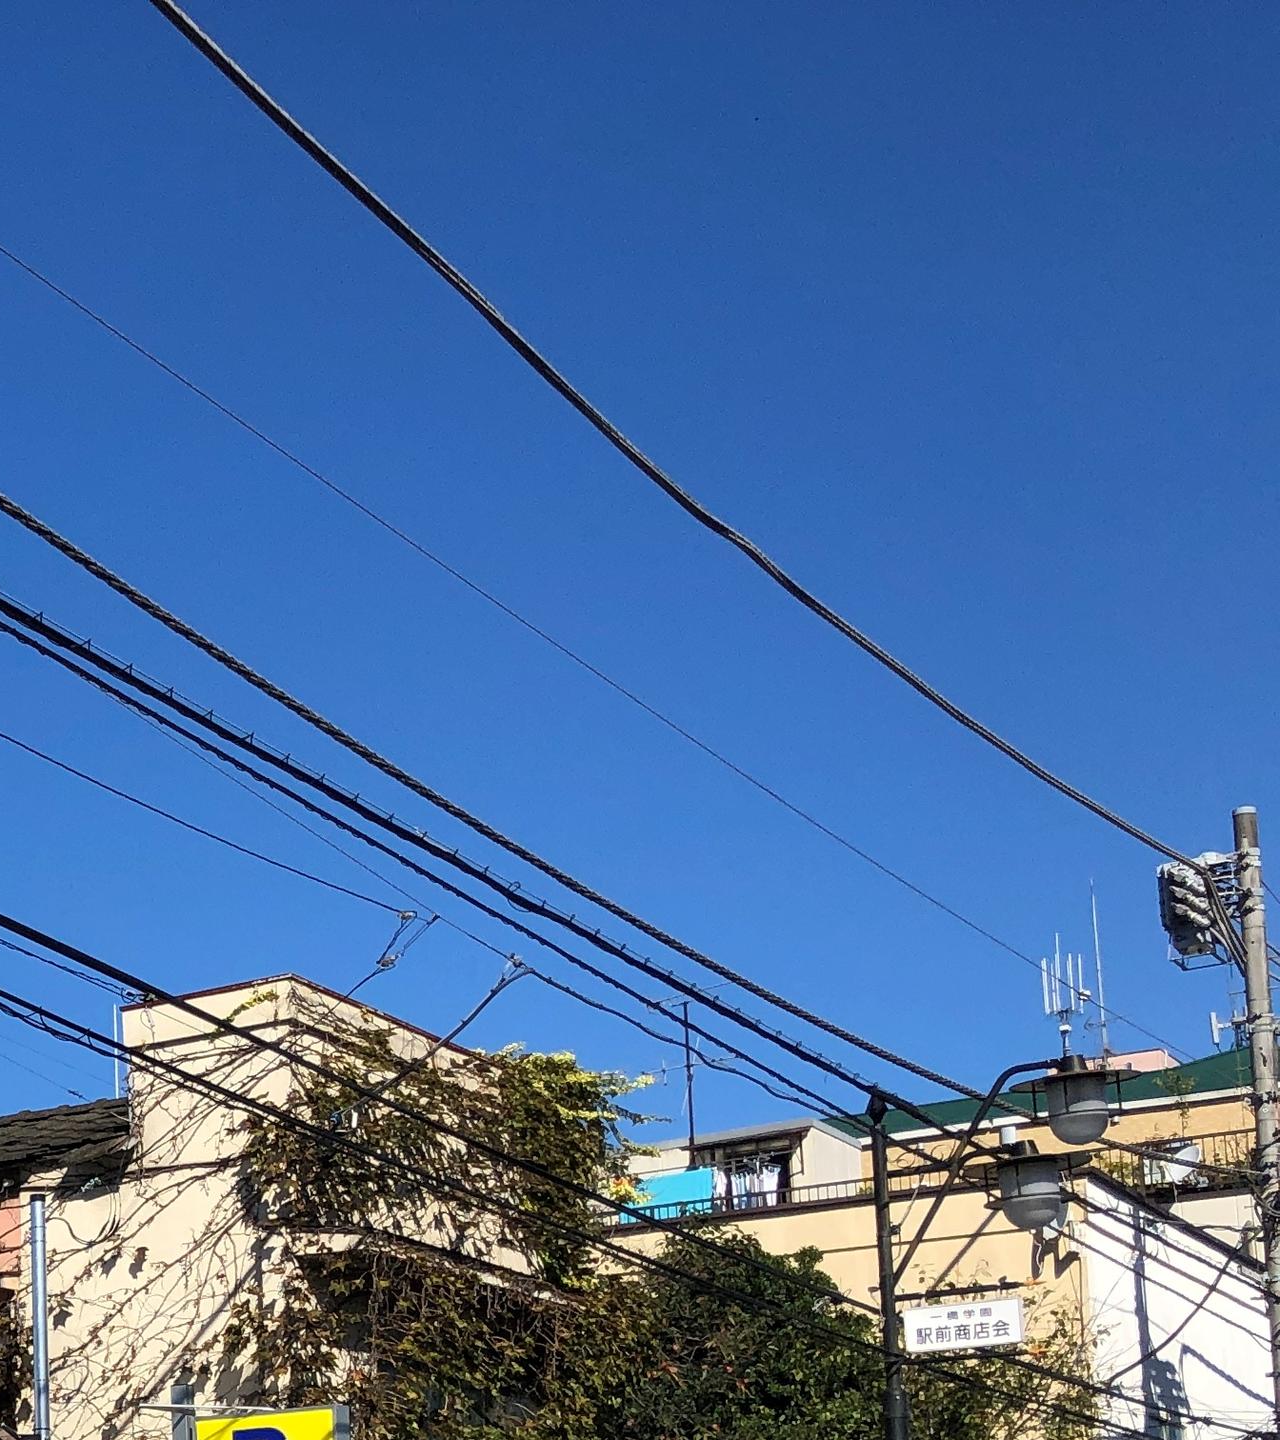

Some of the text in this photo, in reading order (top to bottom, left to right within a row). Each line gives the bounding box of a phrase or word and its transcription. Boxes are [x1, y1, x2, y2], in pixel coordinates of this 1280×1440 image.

[916, 1319, 1010, 1345] 駅前商店会
